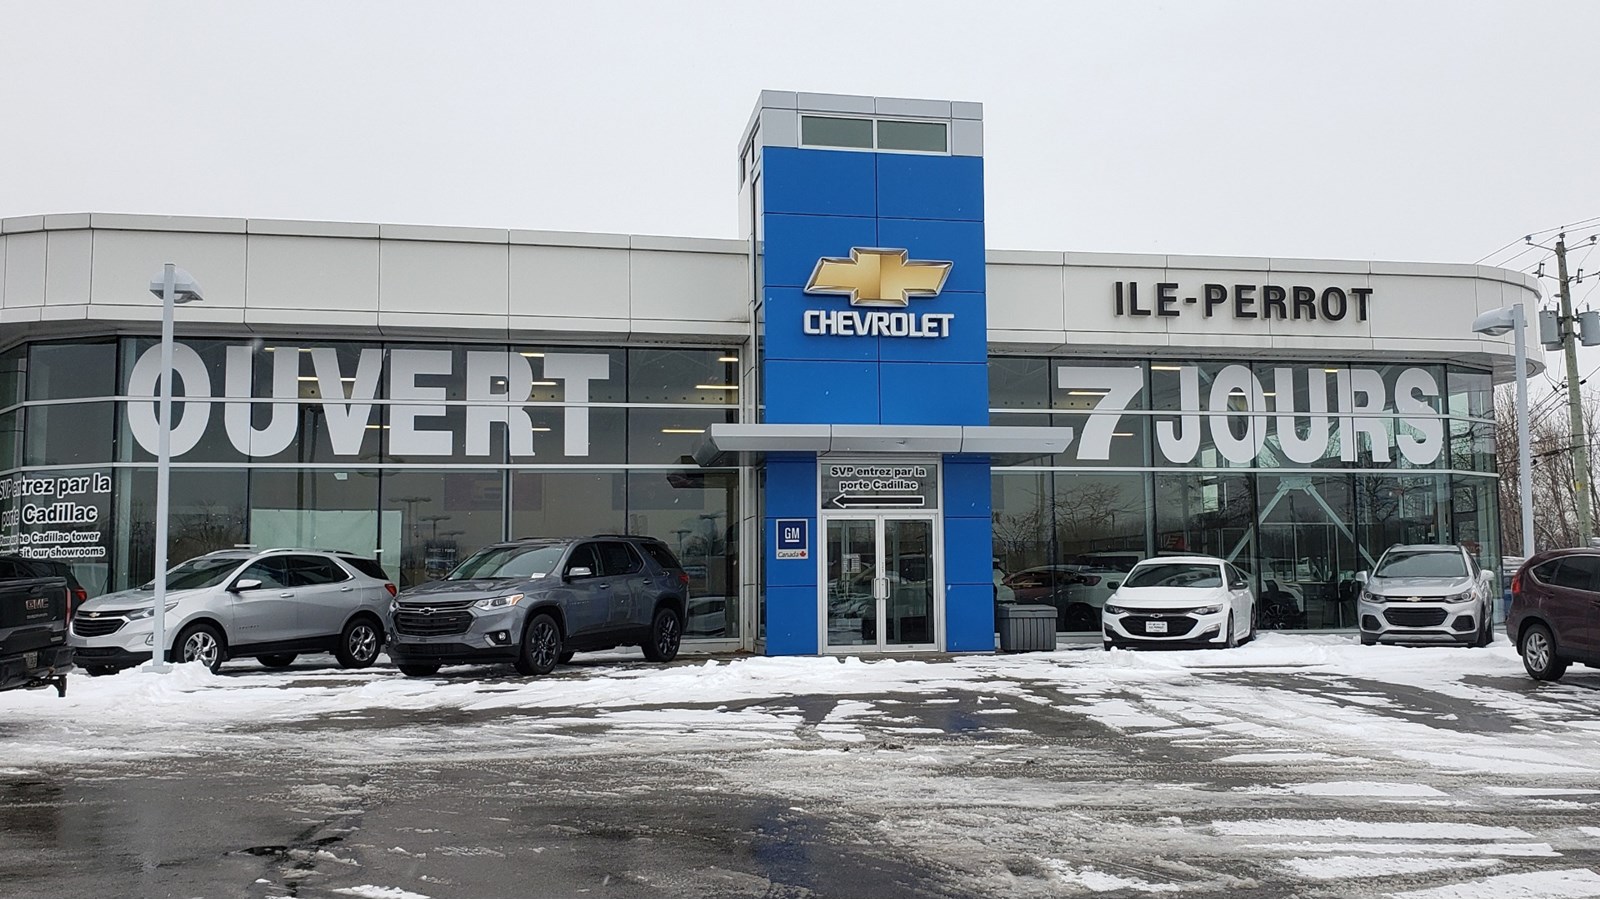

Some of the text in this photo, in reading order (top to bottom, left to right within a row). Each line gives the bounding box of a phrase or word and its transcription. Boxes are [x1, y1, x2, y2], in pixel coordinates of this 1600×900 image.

[1113, 281, 1373, 322] ILE-PERROT
[804, 310, 955, 338] CHEVROLET
[127, 341, 610, 457] OUVERT
[1057, 364, 1443, 465] 7 JOURS
[830, 465, 927, 479] SVP entrez par la
[57, 477, 90, 499] par
[93, 472, 111, 493] la
[840, 479, 919, 492] porte Cadillac
[22, 502, 98, 524] Cadillac
[31, 531, 70, 544] Cadillac
[71, 530, 100, 542] tower
[784, 527, 800, 540] GM
[32, 547, 49, 559] our
[49, 545, 106, 558] showrooms
[777, 550, 800, 558] Canada
